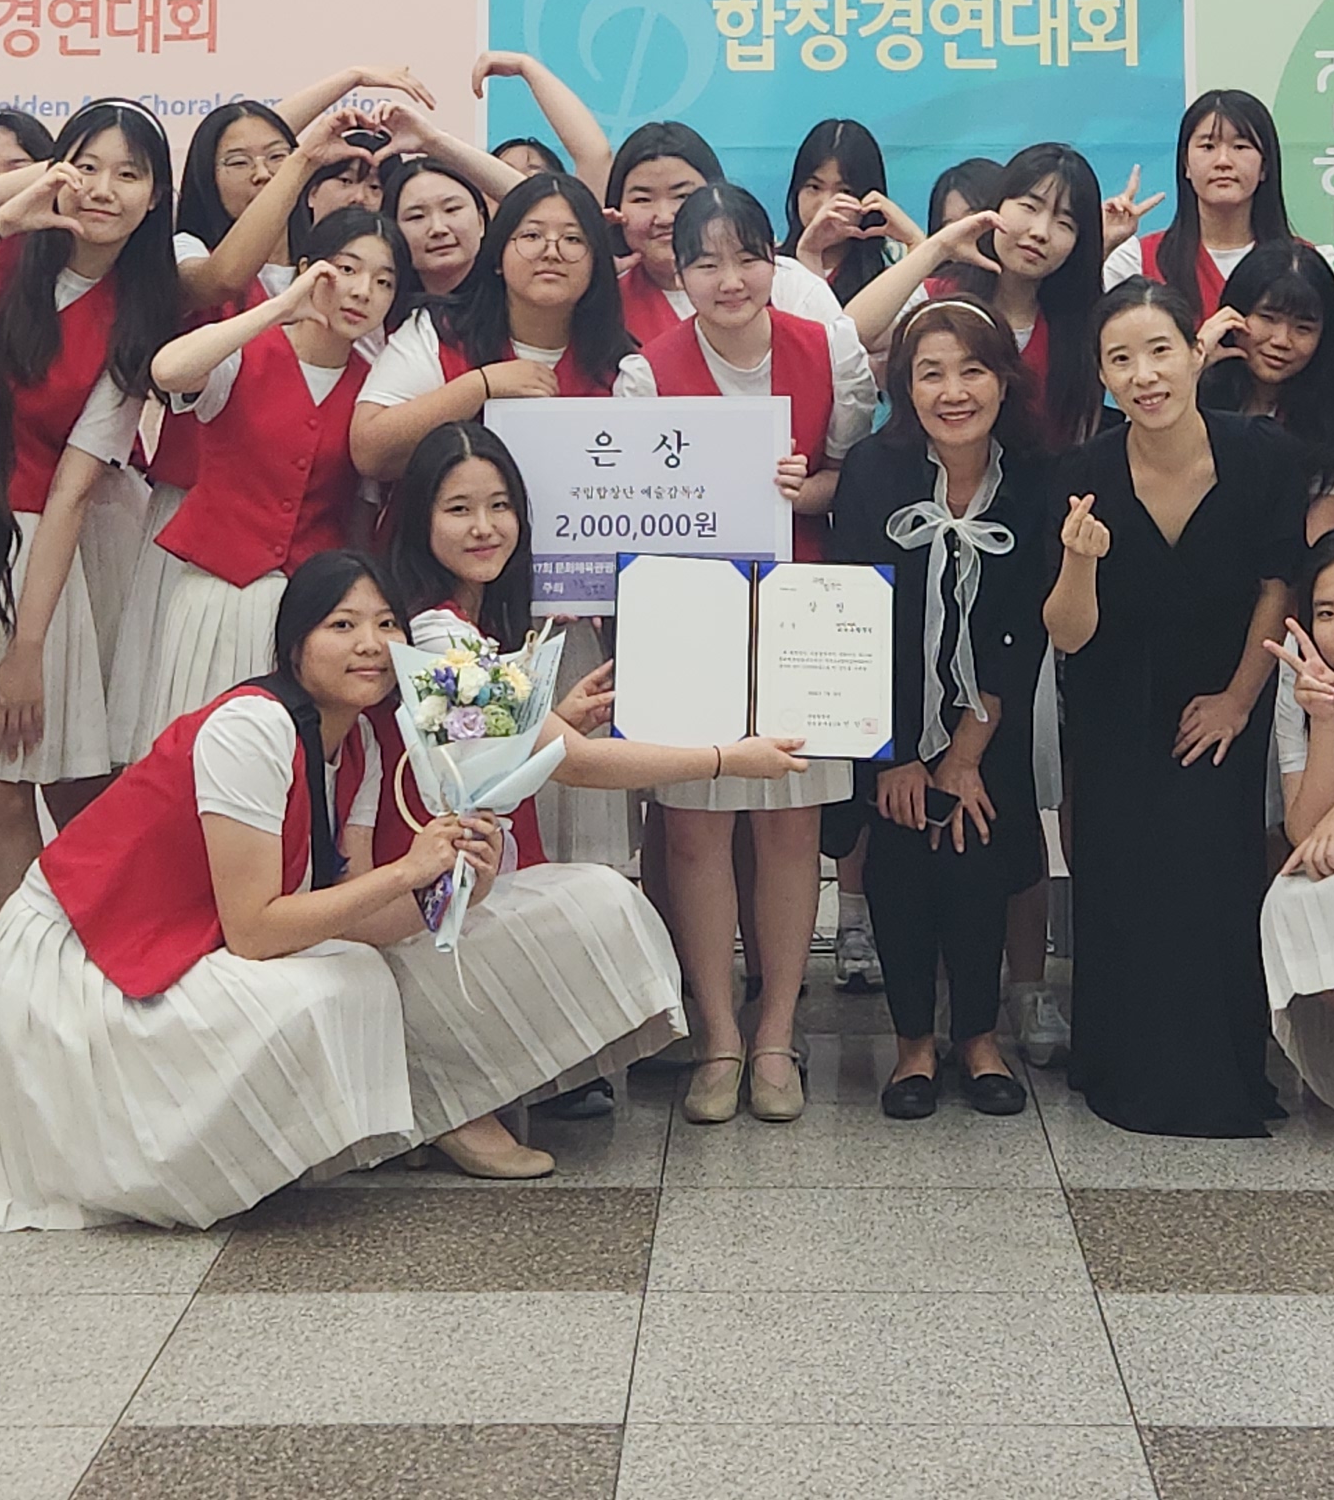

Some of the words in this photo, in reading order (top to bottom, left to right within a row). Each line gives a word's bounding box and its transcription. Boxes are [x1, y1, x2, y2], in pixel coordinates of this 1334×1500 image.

[139, 93, 220, 116] horal
[585, 429, 623, 468] 은
[652, 428, 691, 469] 상
[555, 511, 717, 541] 2,000,000원
